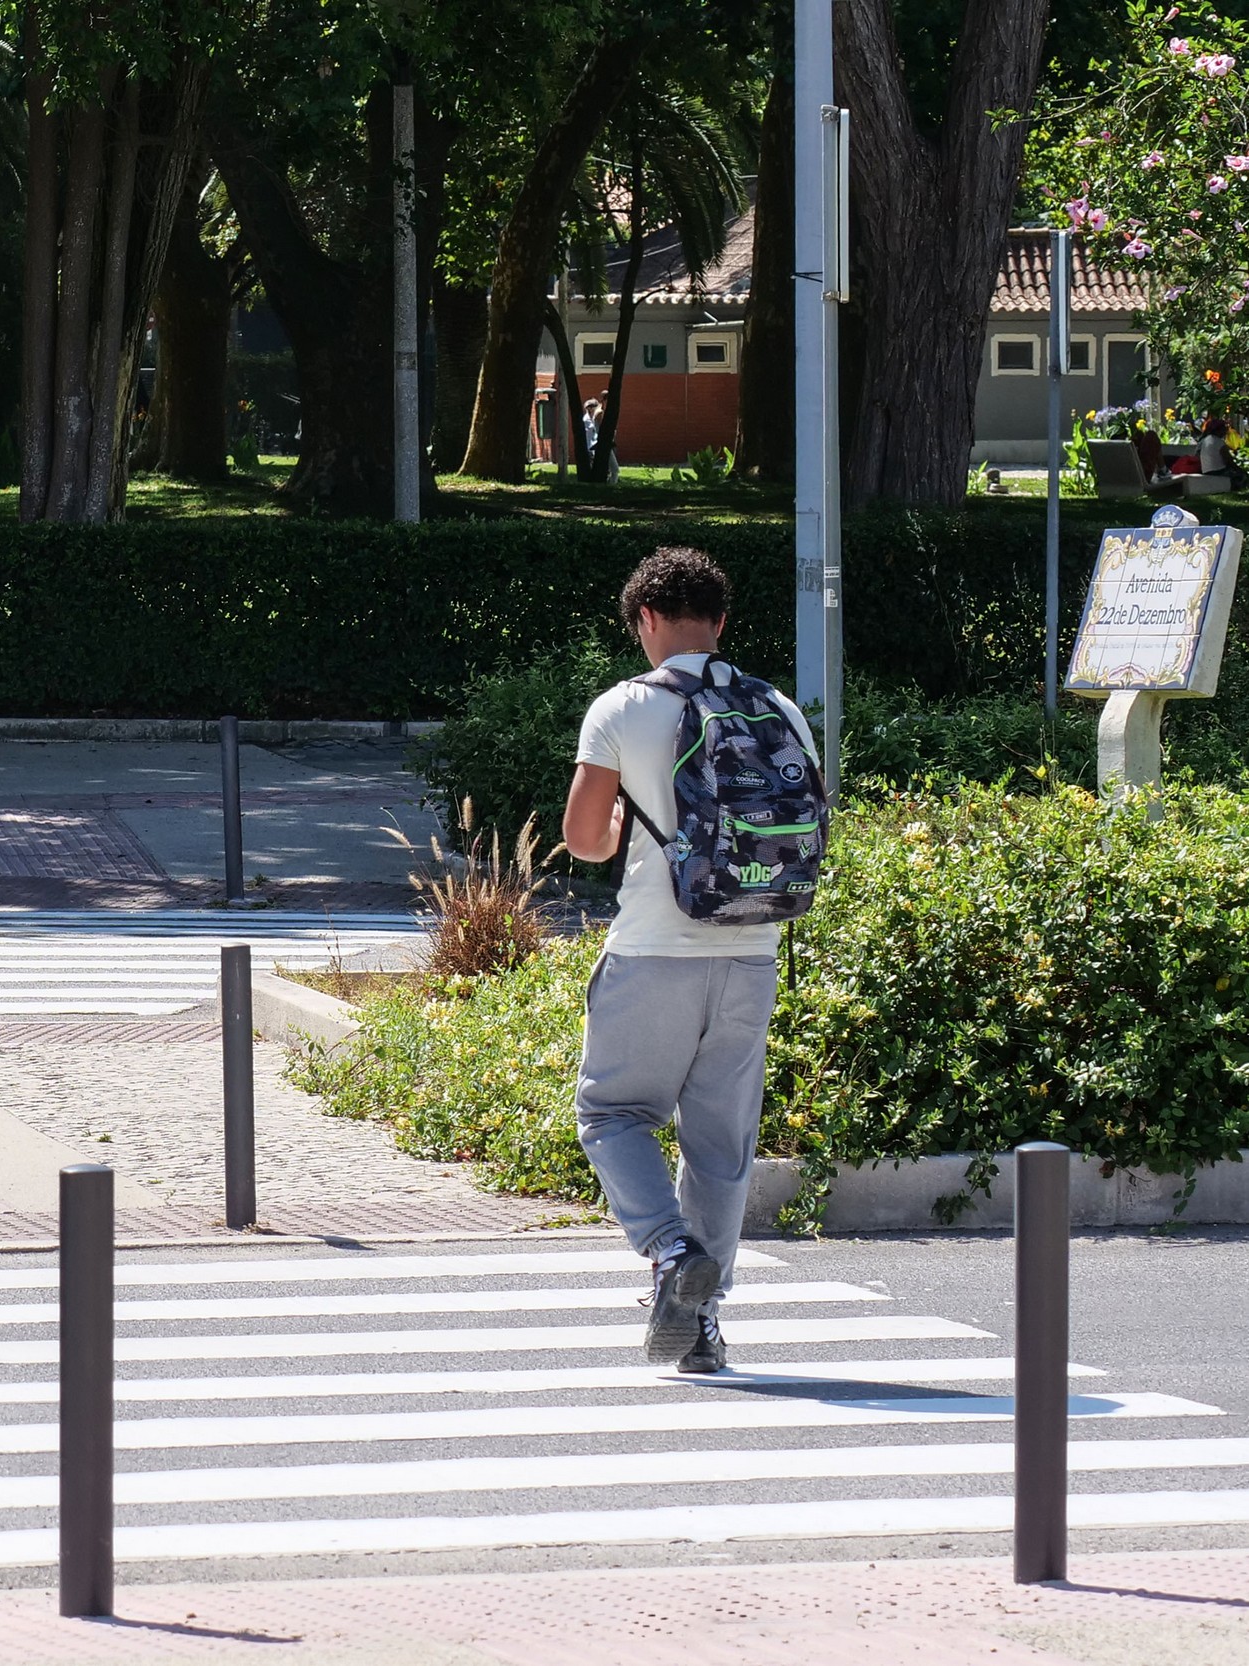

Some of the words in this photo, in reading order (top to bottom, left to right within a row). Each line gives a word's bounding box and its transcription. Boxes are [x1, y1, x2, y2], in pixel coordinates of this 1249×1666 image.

[1125, 572, 1173, 593] Avenida
[1127, 604, 1187, 625] Dezembro
[740, 861, 771, 883] YDG
